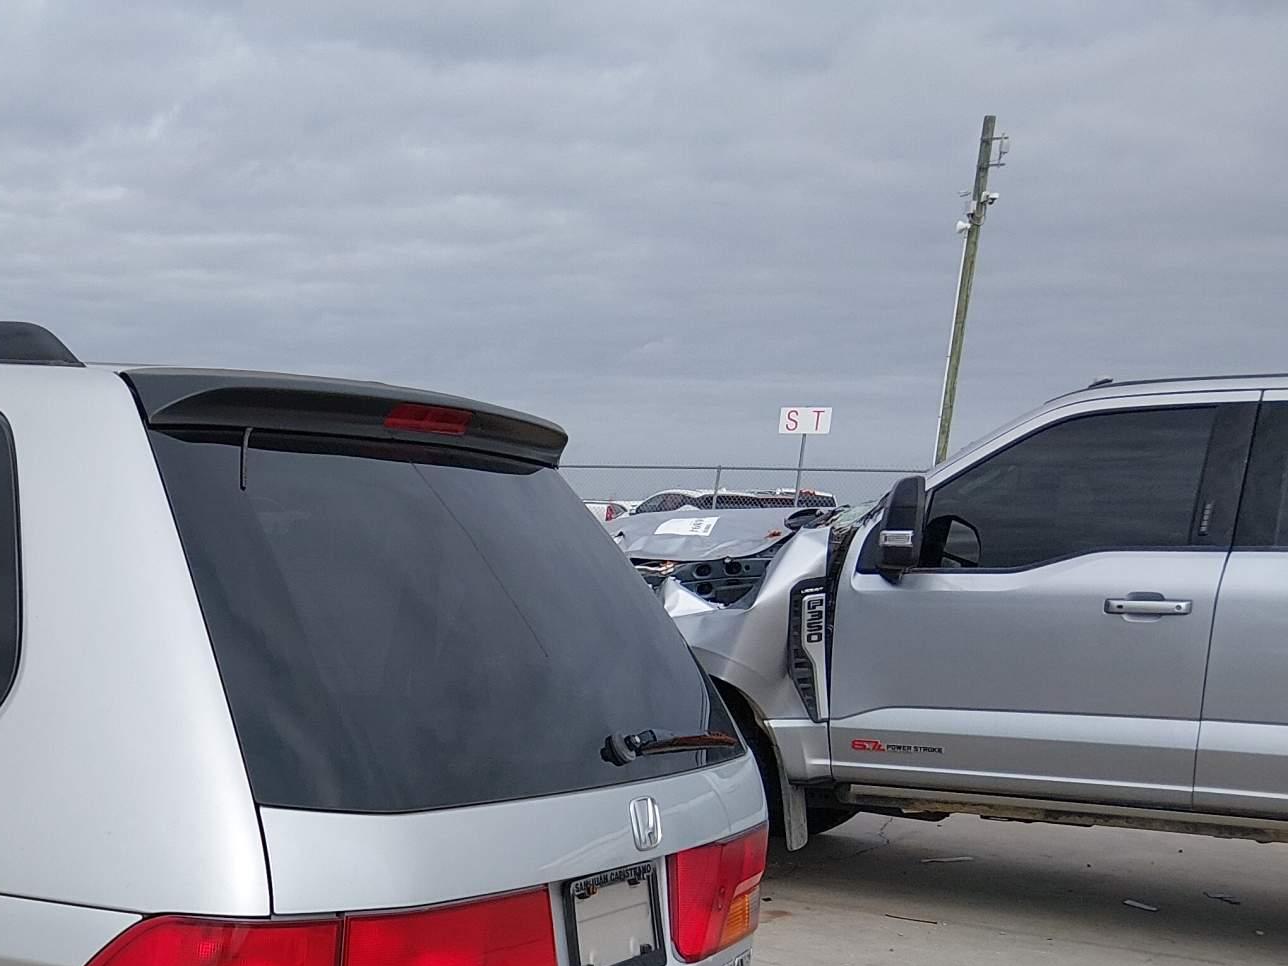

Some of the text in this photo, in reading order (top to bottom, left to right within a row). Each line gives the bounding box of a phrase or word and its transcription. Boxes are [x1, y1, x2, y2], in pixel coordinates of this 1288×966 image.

[785, 409, 825, 431] S T
[807, 599, 824, 643] F350
[887, 744, 912, 752] POWER
[913, 745, 943, 754] STROKE
